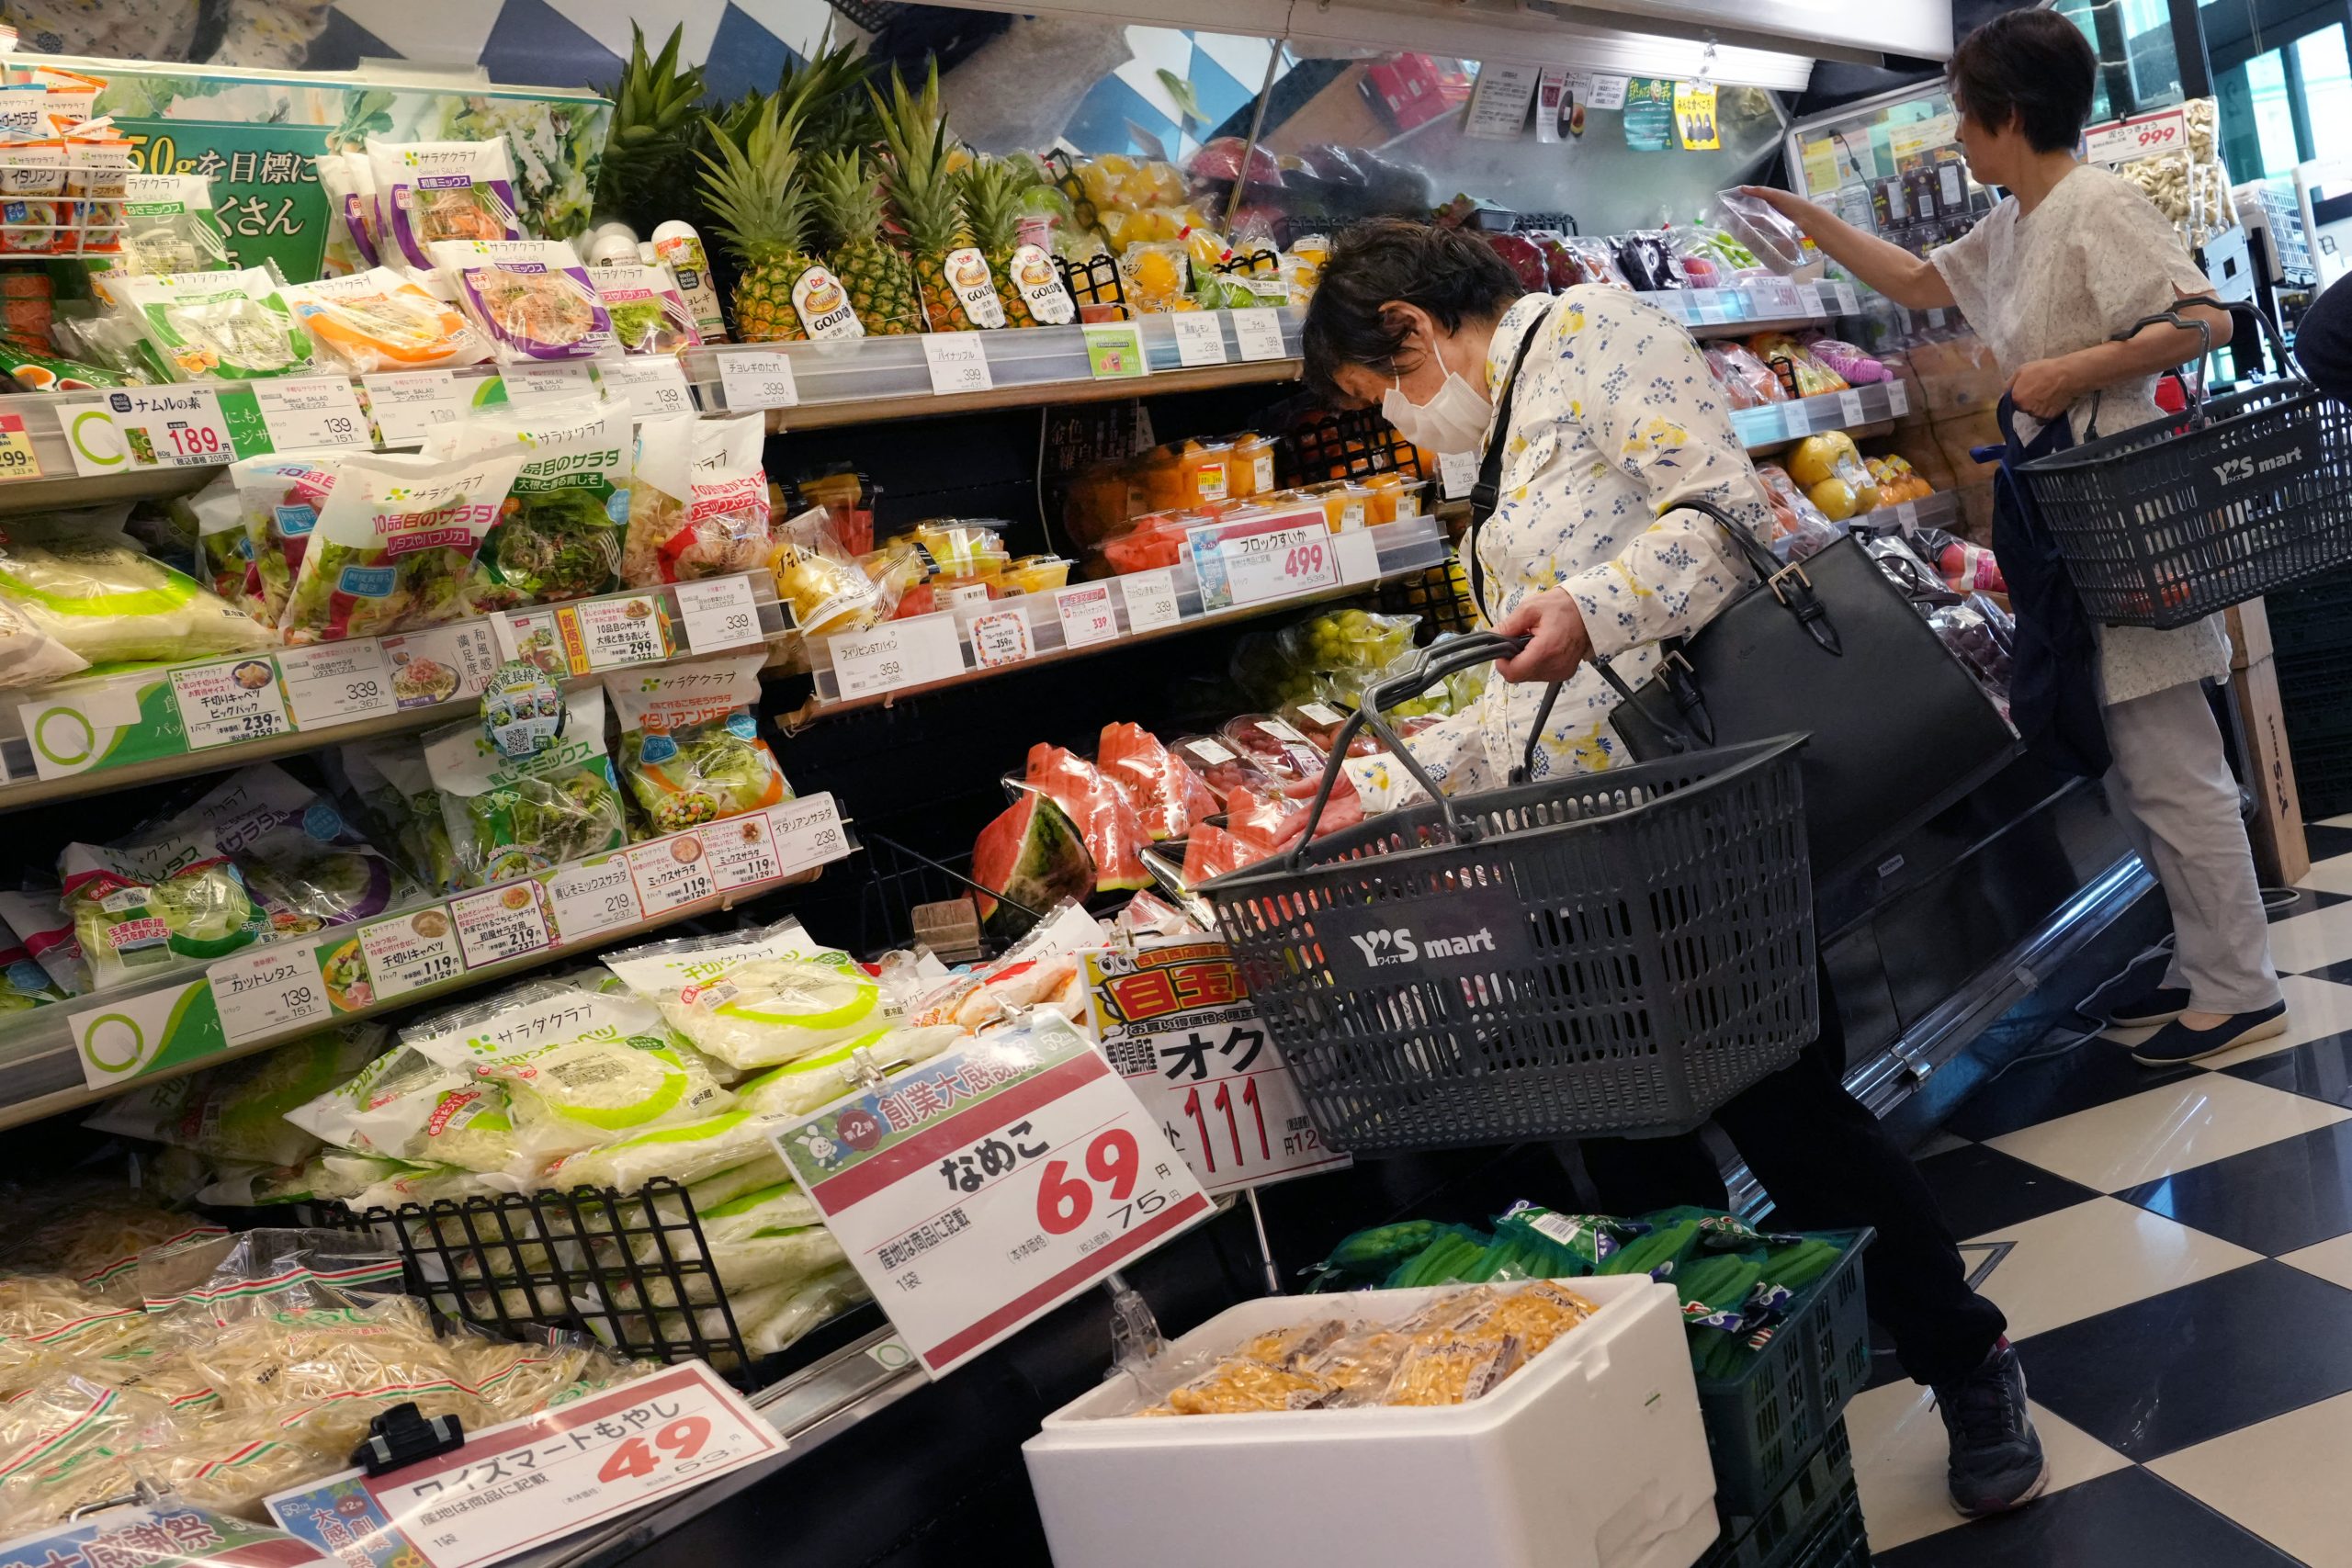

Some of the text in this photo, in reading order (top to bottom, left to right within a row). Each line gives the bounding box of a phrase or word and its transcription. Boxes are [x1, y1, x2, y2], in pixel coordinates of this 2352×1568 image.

[2138, 126, 2176, 147] 999
[420, 151, 478, 164] サラダクラブ
[419, 176, 470, 189] 和風ミックス
[489, 243, 546, 253] サラダクラブ
[967, 286, 991, 302] GOLD
[1031, 282, 1057, 300] GOLD
[814, 310, 843, 332] GOLD
[1204, 341, 1219, 352] 299
[1264, 335, 1278, 347] 199
[729, 362, 781, 374] チョレギのたれ
[963, 368, 981, 382] 399
[655, 388, 679, 403] 139
[763, 382, 785, 396] 399
[134, 396, 201, 413] ナムルの素
[323, 417, 352, 434] 139
[168, 425, 219, 456] 189
[334, 434, 354, 443] 151
[519, 447, 622, 478] 品目のサラダ
[2258, 446, 2303, 473] mart
[517, 472, 601, 492] 大根と香る青じそ
[371, 502, 497, 536] 10品目のサラダ
[389, 530, 466, 554] レタスやパプリカ
[1239, 529, 1307, 553] ブロックすいか
[1284, 543, 1324, 578] 499
[1306, 573, 1326, 585] 539
[1155, 600, 1171, 614] 339
[596, 619, 647, 634] 10品目のサラダ
[725, 614, 749, 630] 339
[1091, 616, 1107, 630] 339
[596, 630, 651, 646] 大根と香る青じそ
[734, 628, 750, 638] 367
[456, 634, 479, 677] 満足度
[473, 628, 493, 671] 和風感
[628, 640, 652, 655] 299
[311, 659, 354, 671] 10品目のサラダ
[879, 660, 900, 677] 359
[488, 668, 547, 696] 鮮度長持ち
[663, 671, 737, 689] サラダクラブ
[200, 689, 260, 708] 千切りキャベツ
[345, 680, 379, 700] 339
[358, 698, 379, 709] 367
[243, 713, 273, 731] 239
[253, 727, 273, 739] 259
[775, 807, 833, 835] イタリアンサラダ
[814, 828, 837, 847] 239
[719, 849, 761, 865] ミックスサラダ
[747, 858, 770, 874] 119
[647, 863, 697, 886] ミックスサラダ
[754, 869, 770, 880] 129
[554, 870, 628, 900] 青じそミックスサラダ
[683, 876, 707, 894] 119
[690, 888, 707, 900] 129
[605, 892, 630, 912] 219
[463, 907, 537, 935] お家で作るごちそうサラダ
[614, 908, 631, 920] 237
[107, 918, 165, 938] 生産者応援
[480, 920, 527, 942] 和風サラダ用
[509, 928, 535, 946] 219
[517, 940, 536, 952] 237
[1423, 926, 1497, 960] mart
[382, 941, 445, 968] 千切りキャベツ
[1377, 954, 1399, 966] ワイズ
[424, 954, 452, 976] 119
[232, 964, 298, 993] カットレタス
[433, 968, 452, 982] 129
[280, 986, 312, 1009] 139
[290, 1004, 313, 1018] 151
[496, 1002, 595, 1045] サラダクラブ
[1159, 1026, 1266, 1081] オク
[1183, 1075, 1272, 1175] 111
[939, 1119, 1051, 1194] なめこ
[1035, 1127, 1140, 1235] 69
[1106, 1189, 1169, 1230] 75
[876, 1205, 974, 1272] 産地は商品に記載
[894, 1269, 922, 1293] 1袋
[412, 1399, 683, 1498] ワイズマートもやし
[596, 1414, 713, 1484] 49
[673, 1448, 732, 1475] 53
[418, 1472, 551, 1528] 産地は商品に記載
[432, 1534, 460, 1551] 1袋
